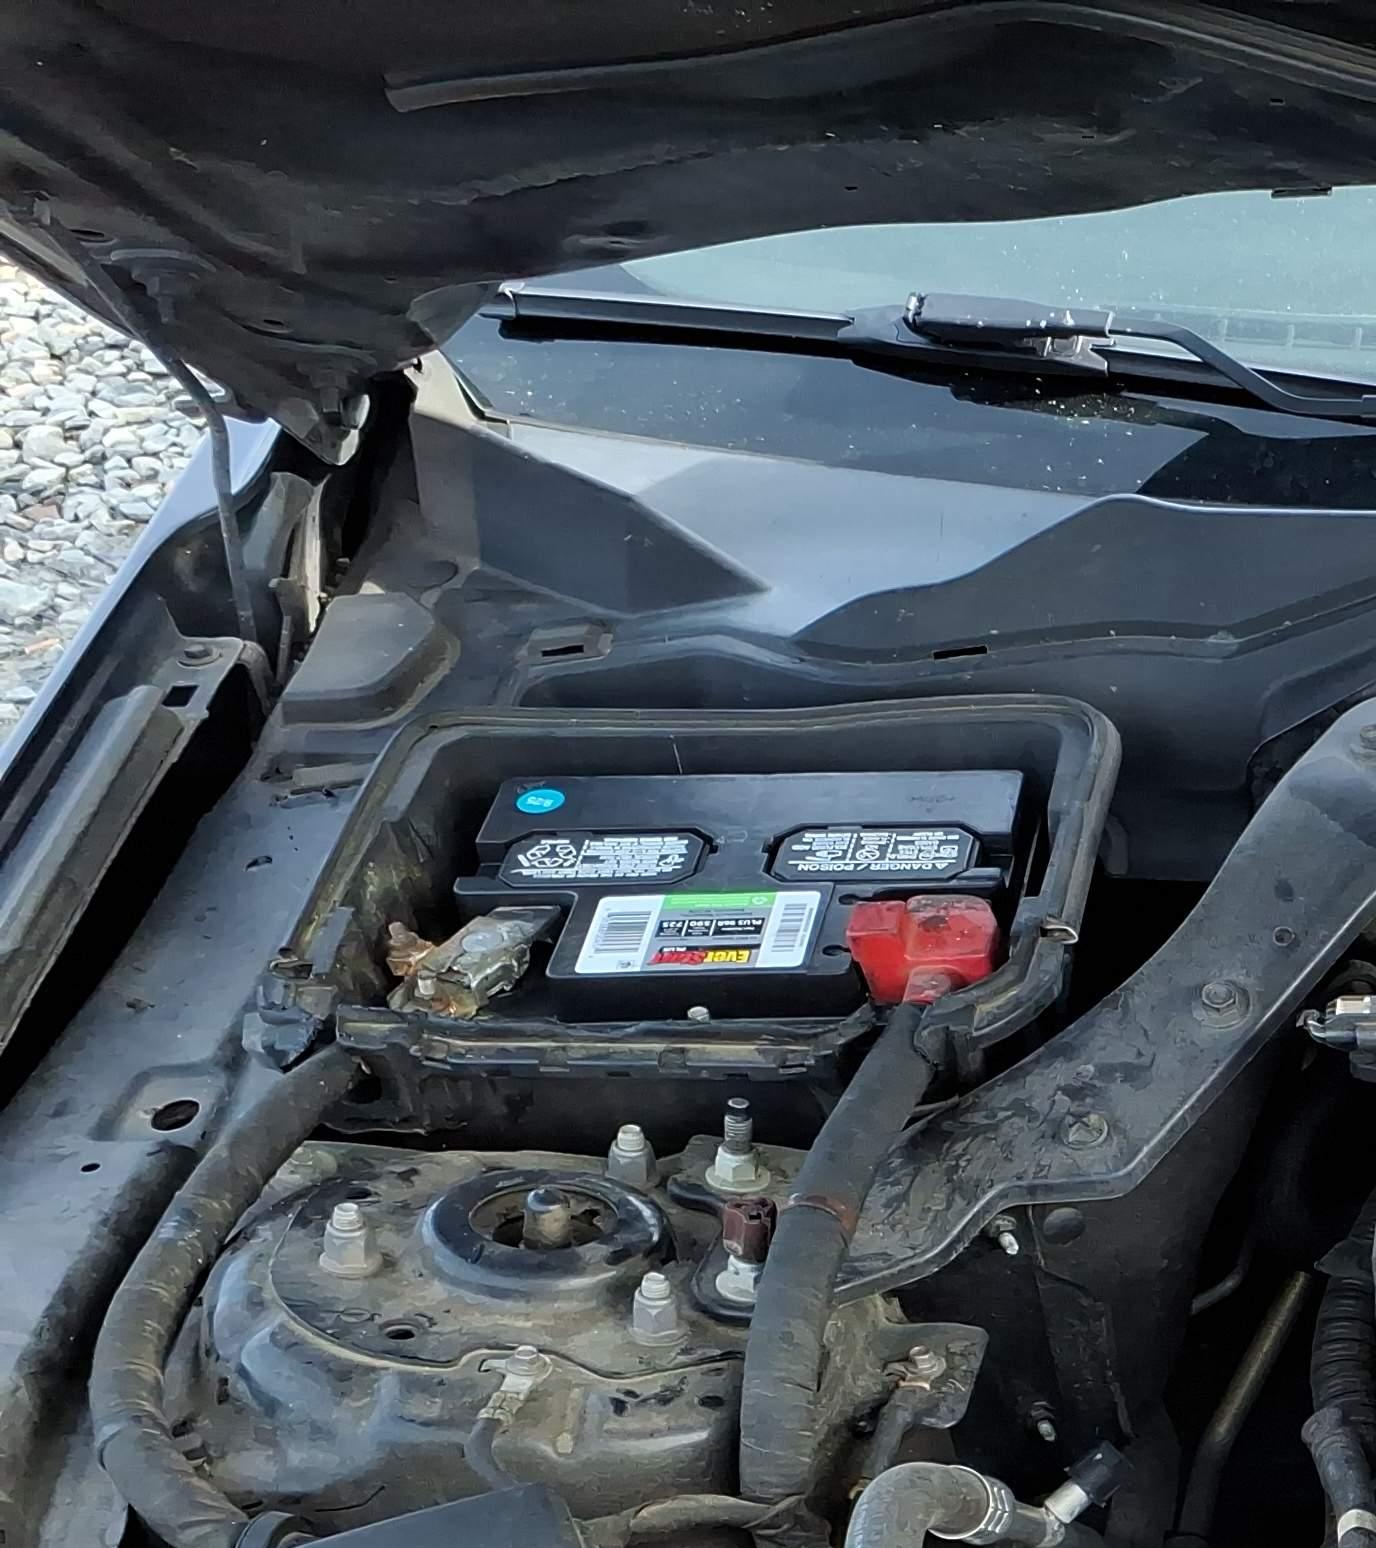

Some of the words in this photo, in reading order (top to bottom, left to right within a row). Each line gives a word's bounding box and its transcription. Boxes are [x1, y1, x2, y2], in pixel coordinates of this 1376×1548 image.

[797, 862, 855, 872] POISON
[870, 862, 933, 872] DANGER
[647, 949, 752, 966] EverStart
